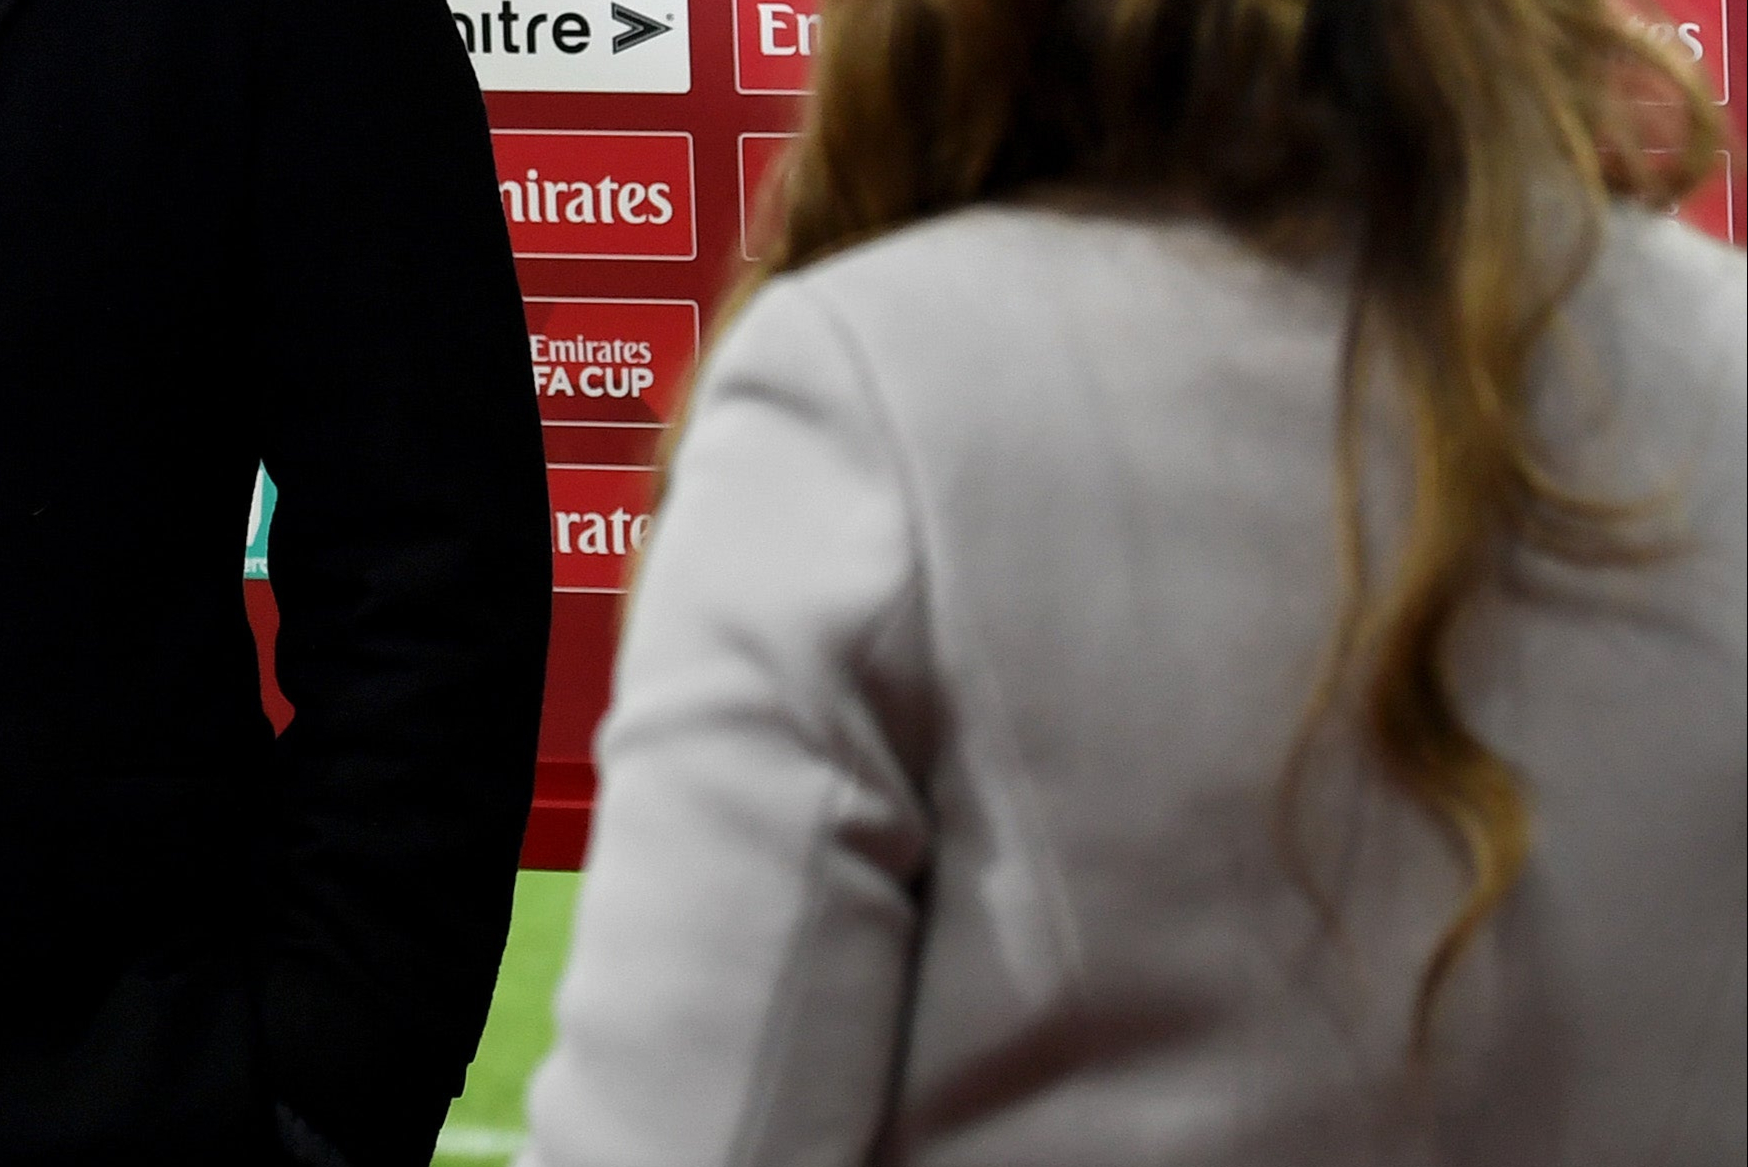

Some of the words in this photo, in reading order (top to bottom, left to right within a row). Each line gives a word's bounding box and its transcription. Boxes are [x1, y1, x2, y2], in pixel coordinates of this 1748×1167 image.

[531, 334, 652, 364] Emirates
[533, 365, 574, 396] FA
[579, 365, 654, 398] CUP
